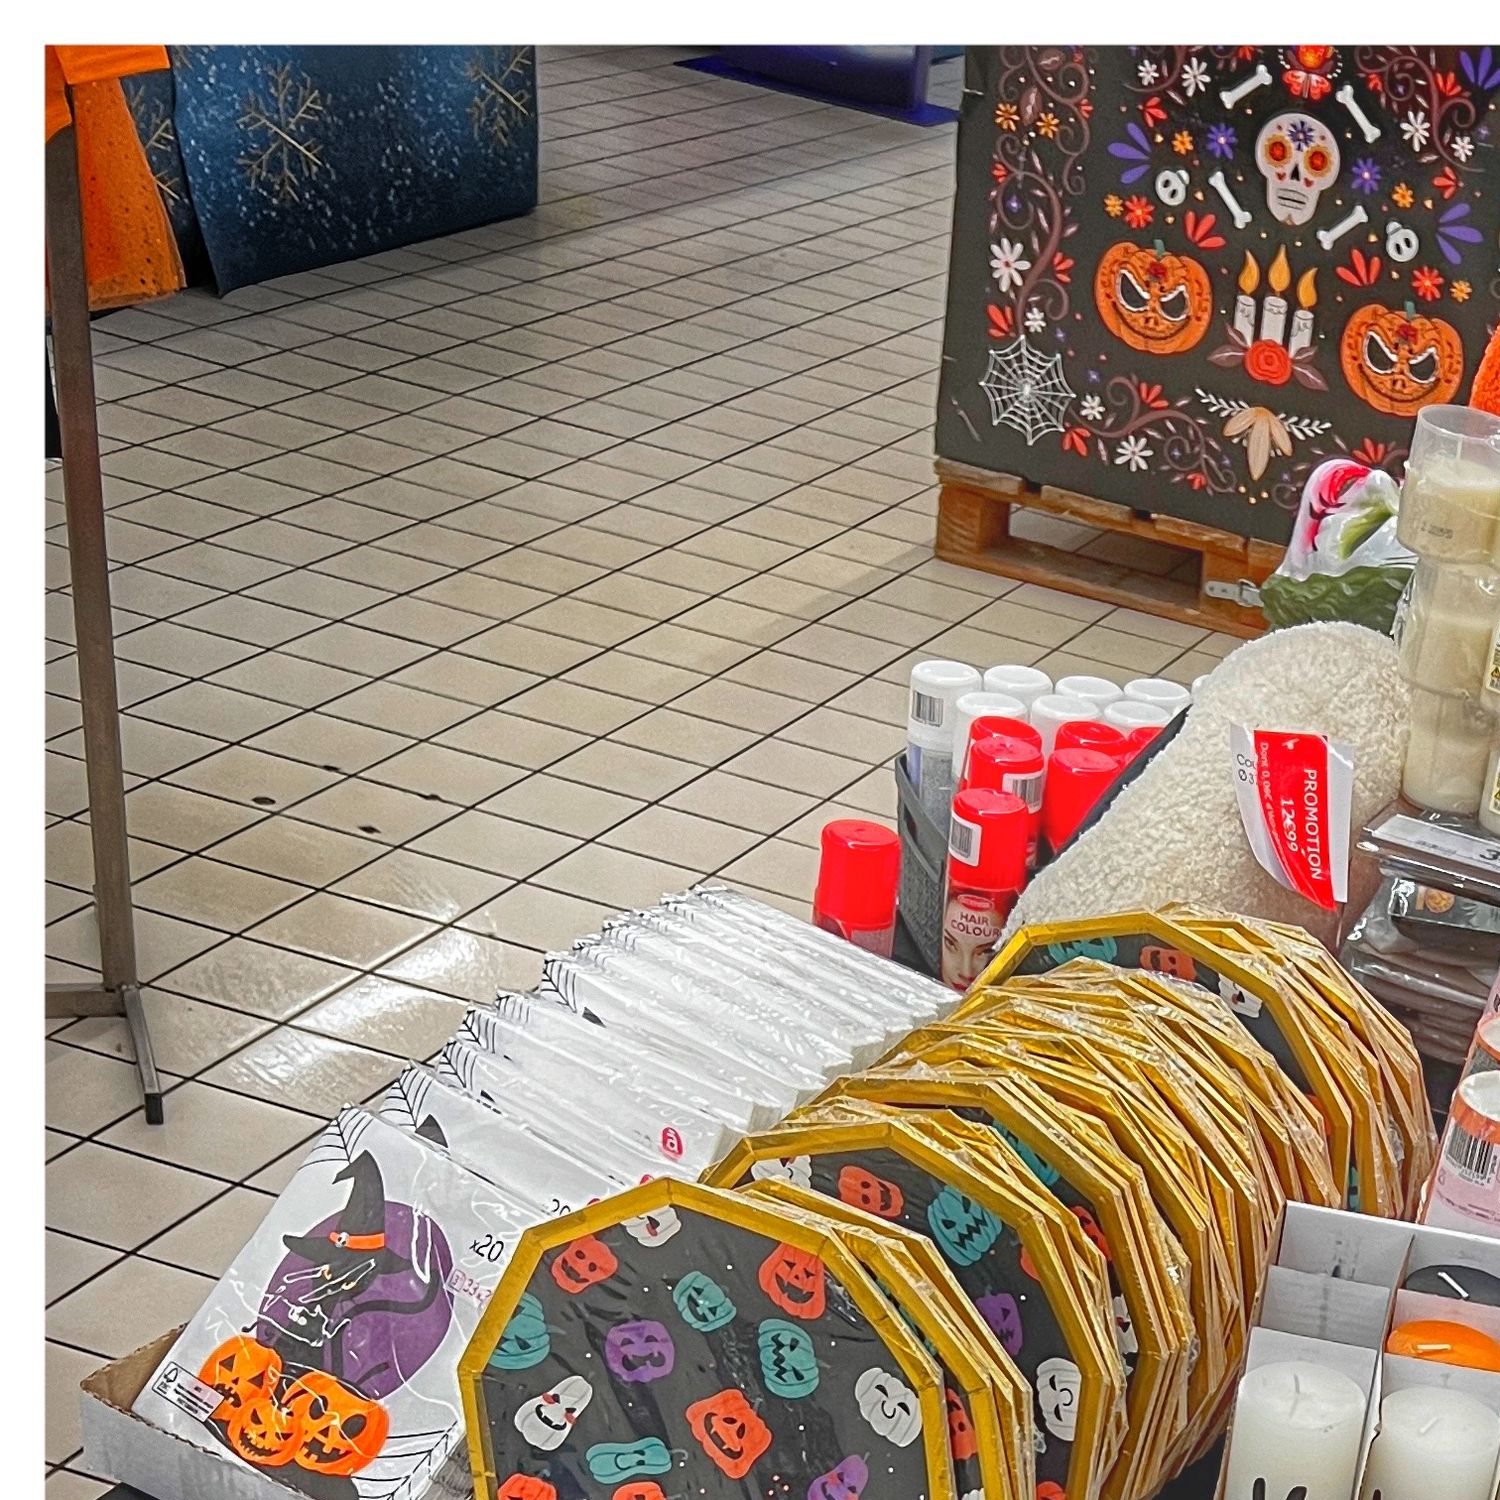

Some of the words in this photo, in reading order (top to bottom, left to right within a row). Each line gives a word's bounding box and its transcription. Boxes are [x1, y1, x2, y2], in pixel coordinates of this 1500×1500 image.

[1303, 769, 1323, 880] PROMOTION
[951, 920, 1002, 937] COLOUR
[960, 912, 989, 926] HAIR
[469, 1234, 505, 1262] x20
